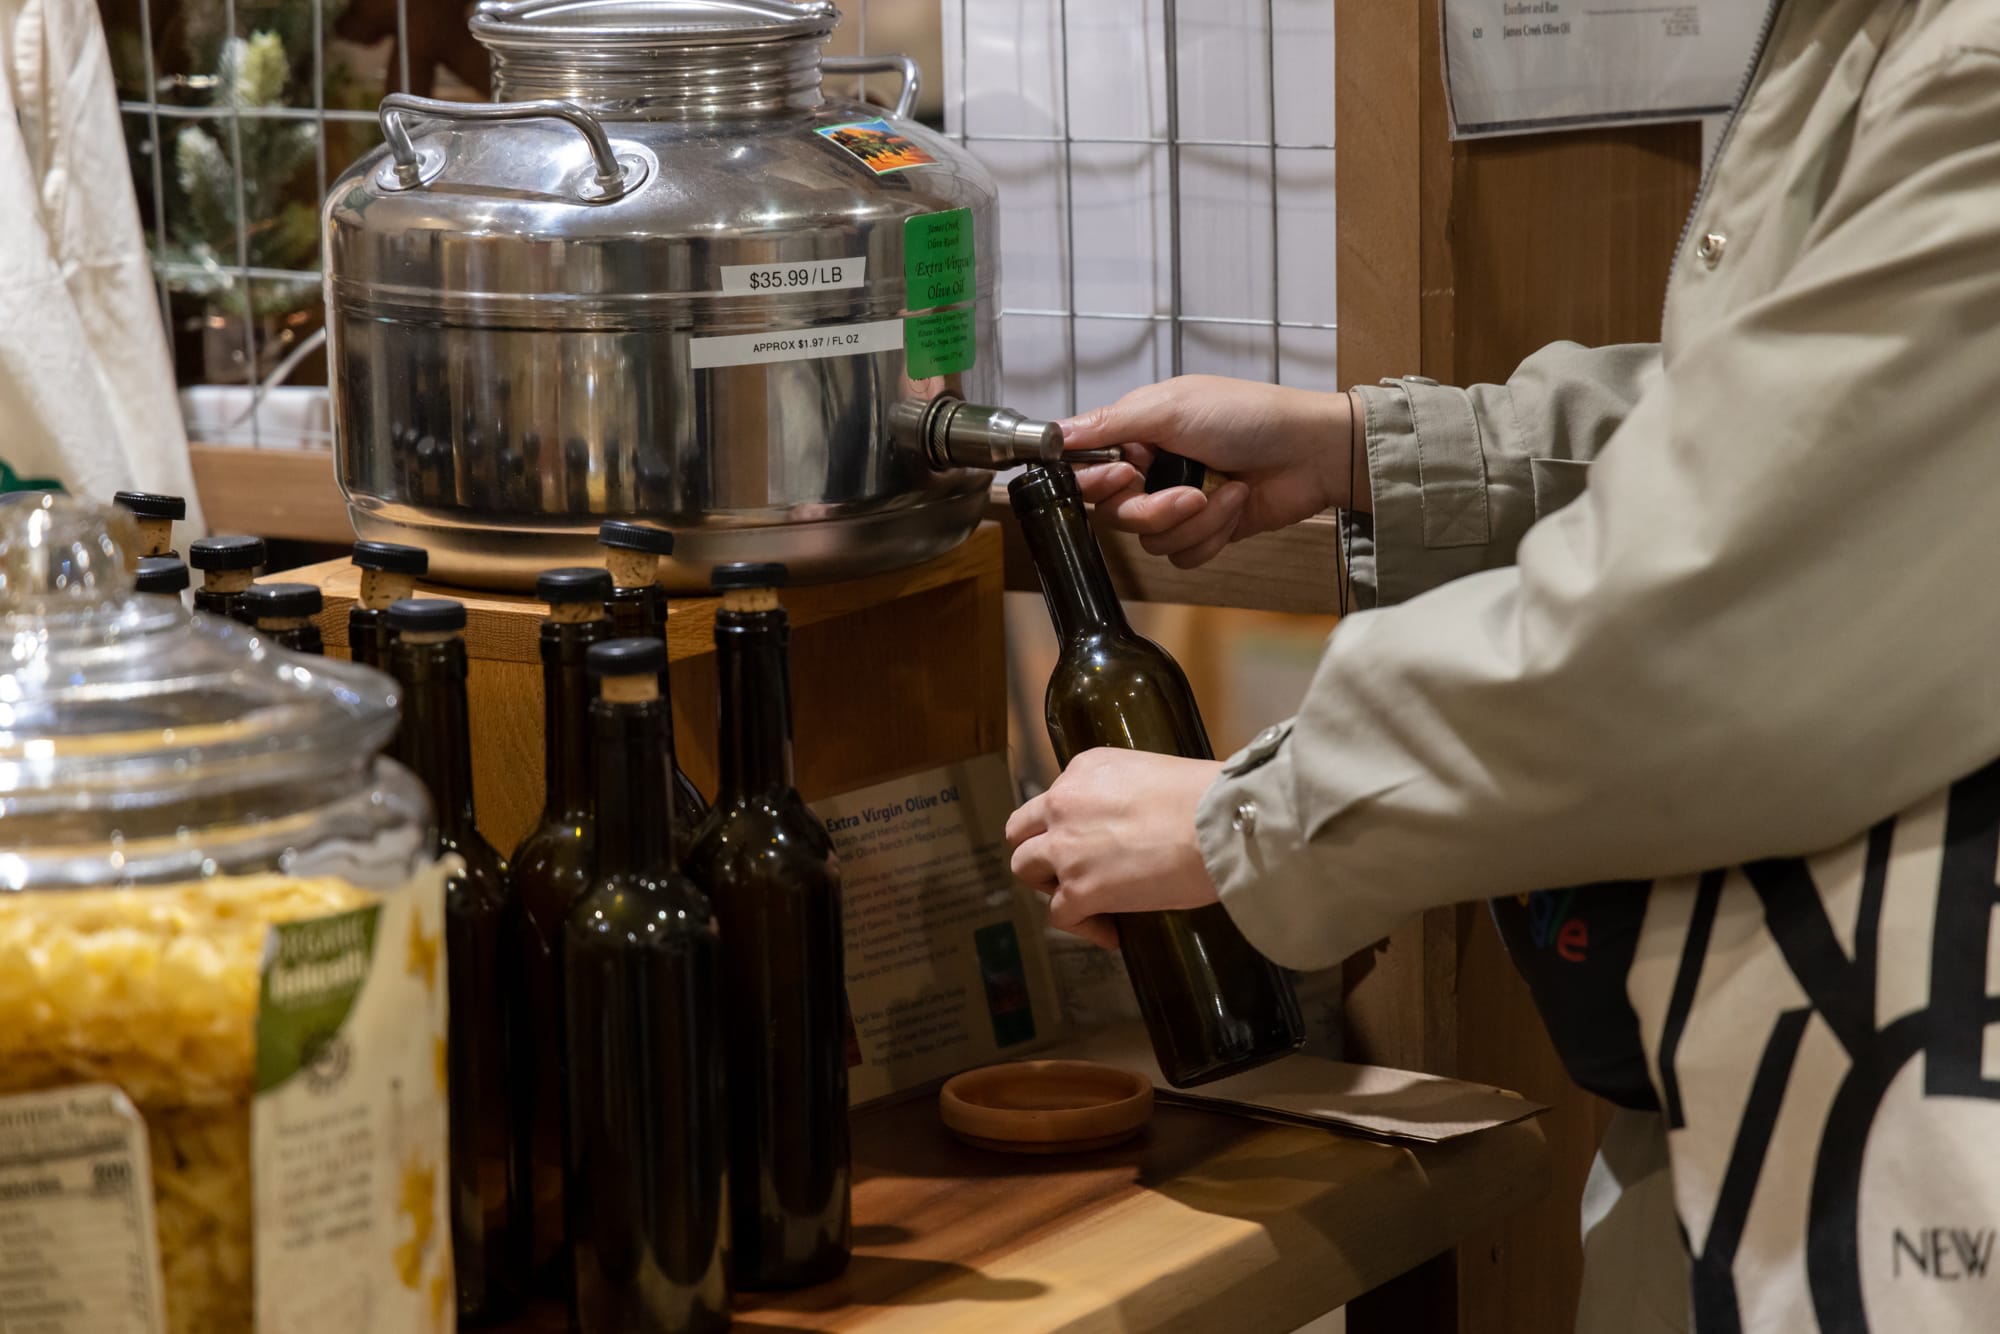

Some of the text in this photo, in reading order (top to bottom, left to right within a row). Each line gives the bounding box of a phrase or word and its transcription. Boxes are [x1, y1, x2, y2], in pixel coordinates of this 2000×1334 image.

[1560, 21, 1570, 34] Oil
[750, 269, 808, 290] $35.99
[821, 266, 842, 284] LB
[915, 256, 969, 278] Extra Virgin
[928, 278, 965, 300] Olive Oil
[753, 340, 796, 353] APPROX
[798, 337, 824, 349] $1.97
[832, 336, 844, 346] FL
[846, 334, 859, 345] OZ
[825, 784, 960, 833] Extra Virgin Olive Oil
[860, 831, 876, 842] and
[1893, 1226, 1996, 1282] NEW
